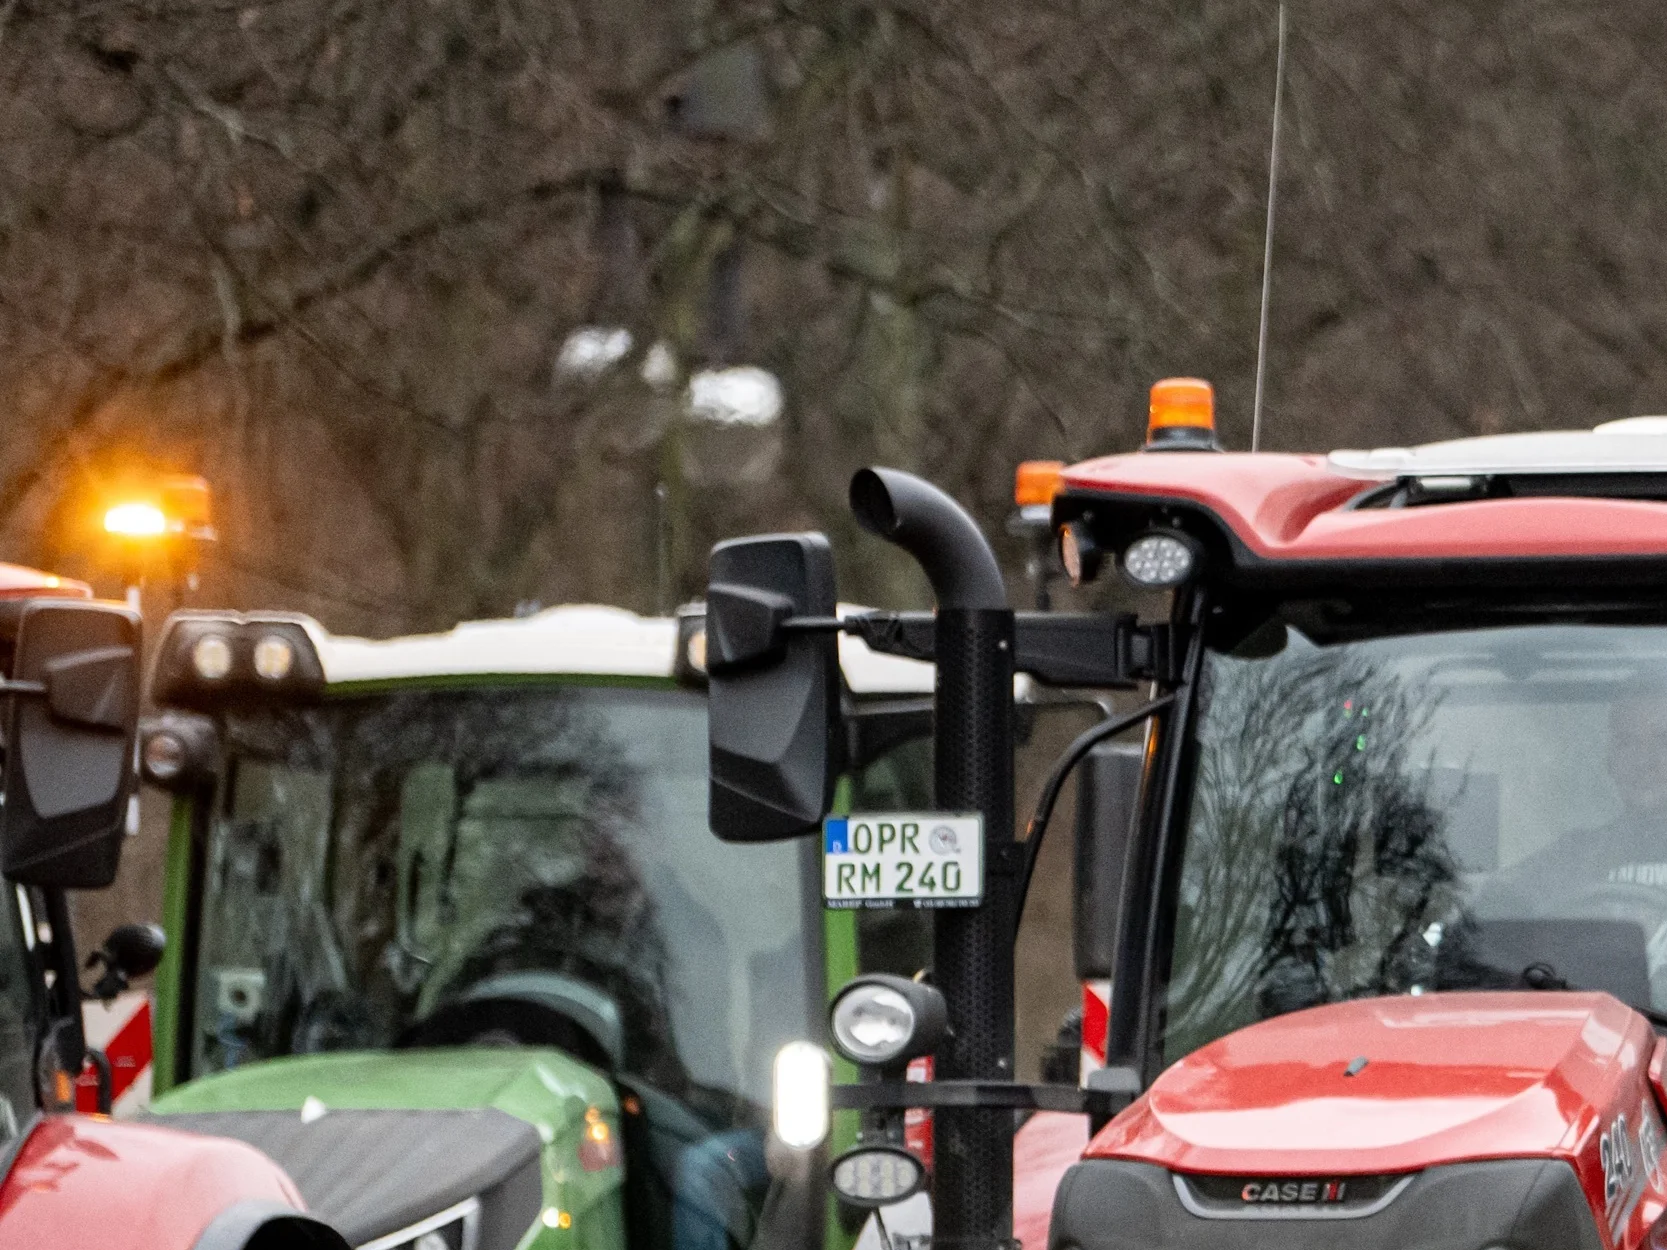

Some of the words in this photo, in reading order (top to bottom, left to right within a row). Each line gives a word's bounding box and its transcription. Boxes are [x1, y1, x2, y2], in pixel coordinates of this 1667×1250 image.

[853, 823, 920, 853] OPR
[837, 862, 881, 894] RM
[895, 861, 961, 893] 240
[1241, 1182, 1318, 1202] CASE
